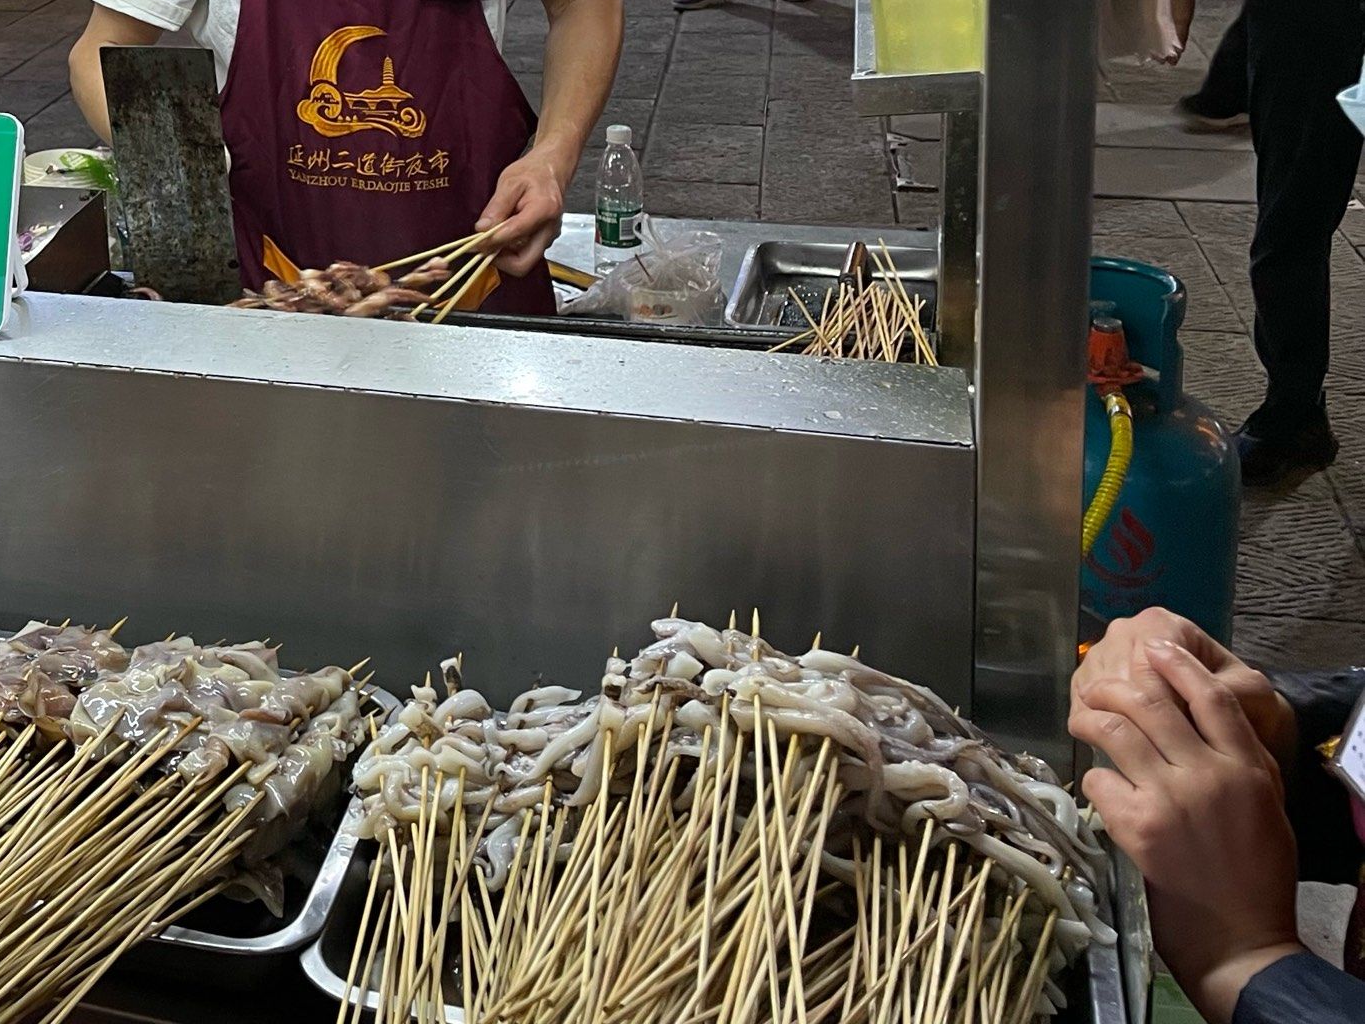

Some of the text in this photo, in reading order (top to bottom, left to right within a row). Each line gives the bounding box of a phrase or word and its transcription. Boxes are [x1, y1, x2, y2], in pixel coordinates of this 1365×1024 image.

[287, 144, 450, 178] 延州二道街夜市
[288, 168, 450, 194] YANZHOU ERDAOJIE YESHI
